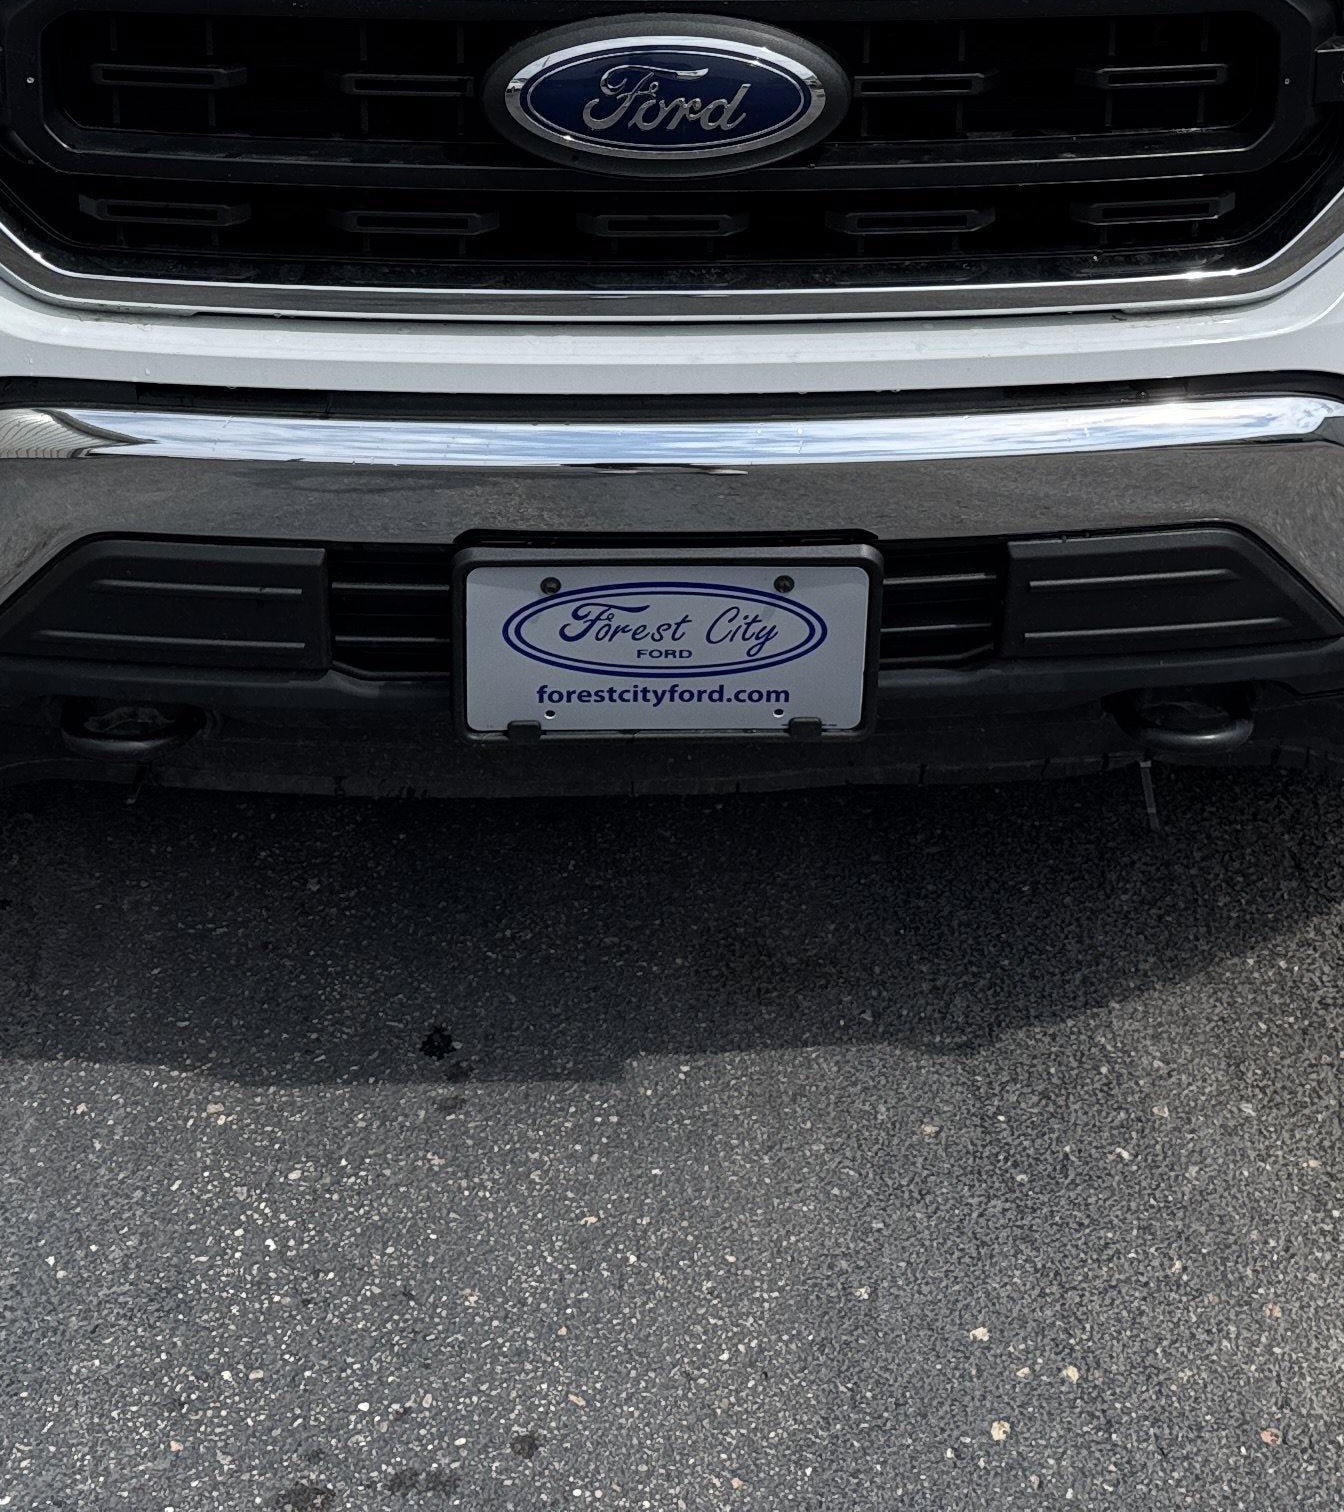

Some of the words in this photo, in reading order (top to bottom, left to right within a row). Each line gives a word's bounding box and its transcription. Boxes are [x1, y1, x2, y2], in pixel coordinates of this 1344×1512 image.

[582, 64, 751, 131] Ford
[559, 602, 693, 642] Forest
[705, 606, 778, 657] City
[636, 648, 692, 659] FORD
[536, 684, 790, 707] forestcityford.com
